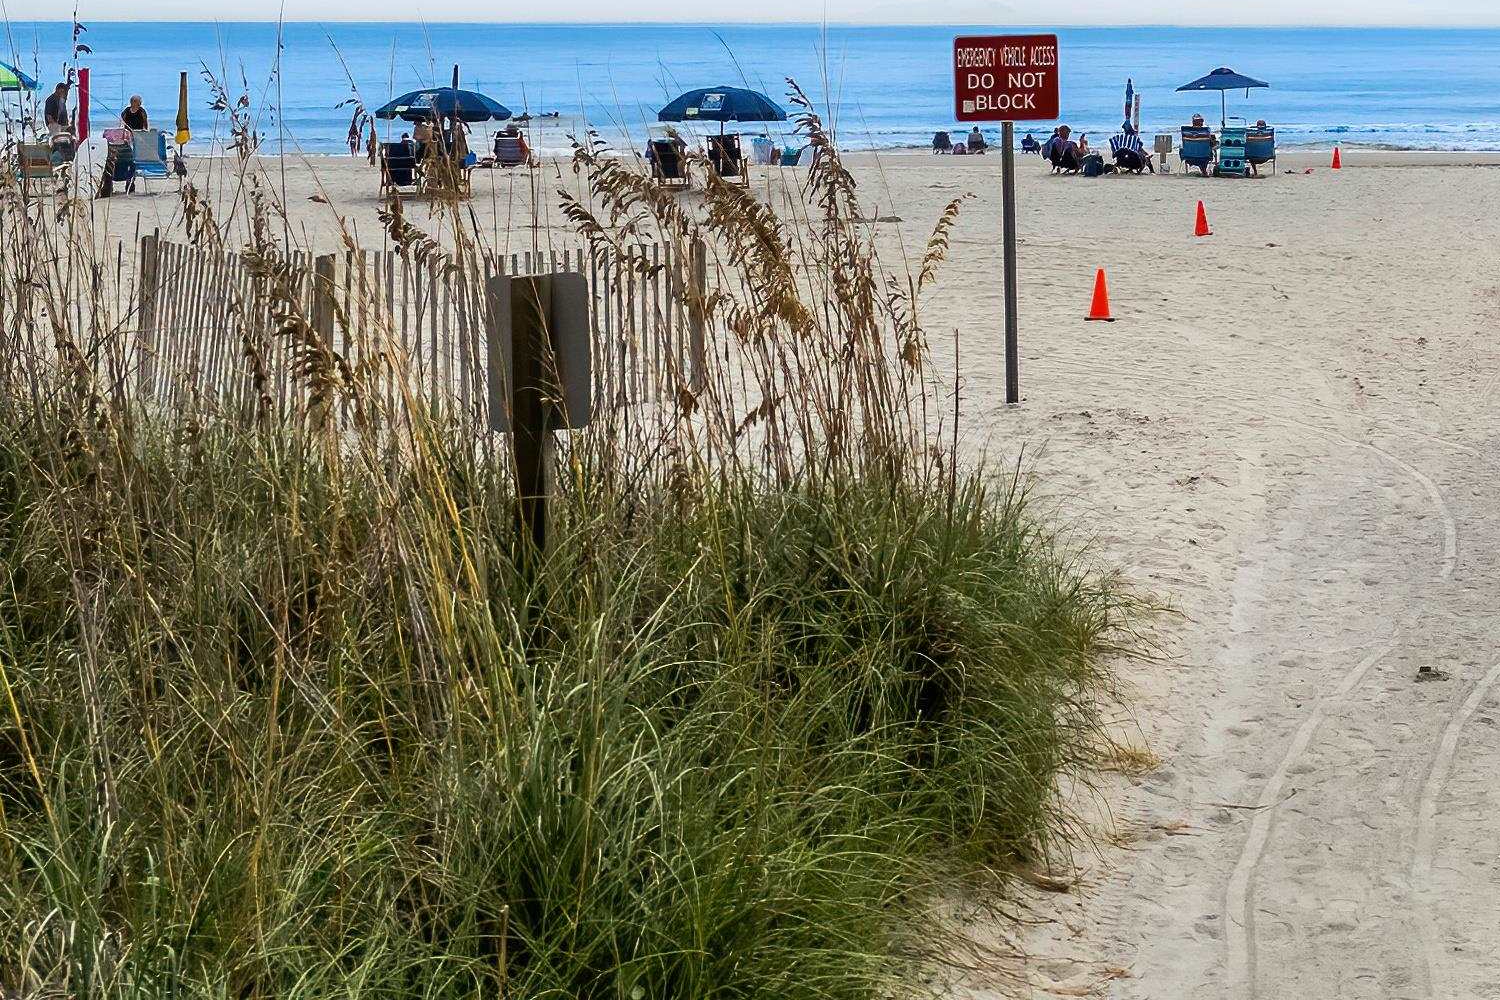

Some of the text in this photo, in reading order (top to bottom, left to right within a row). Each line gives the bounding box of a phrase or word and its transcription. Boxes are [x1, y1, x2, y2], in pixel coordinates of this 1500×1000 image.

[957, 45, 1055, 68] EMERGENCY VEHICLE ACCESS
[967, 72, 1046, 90] DO NOT
[976, 93, 1036, 110] BLOCK
